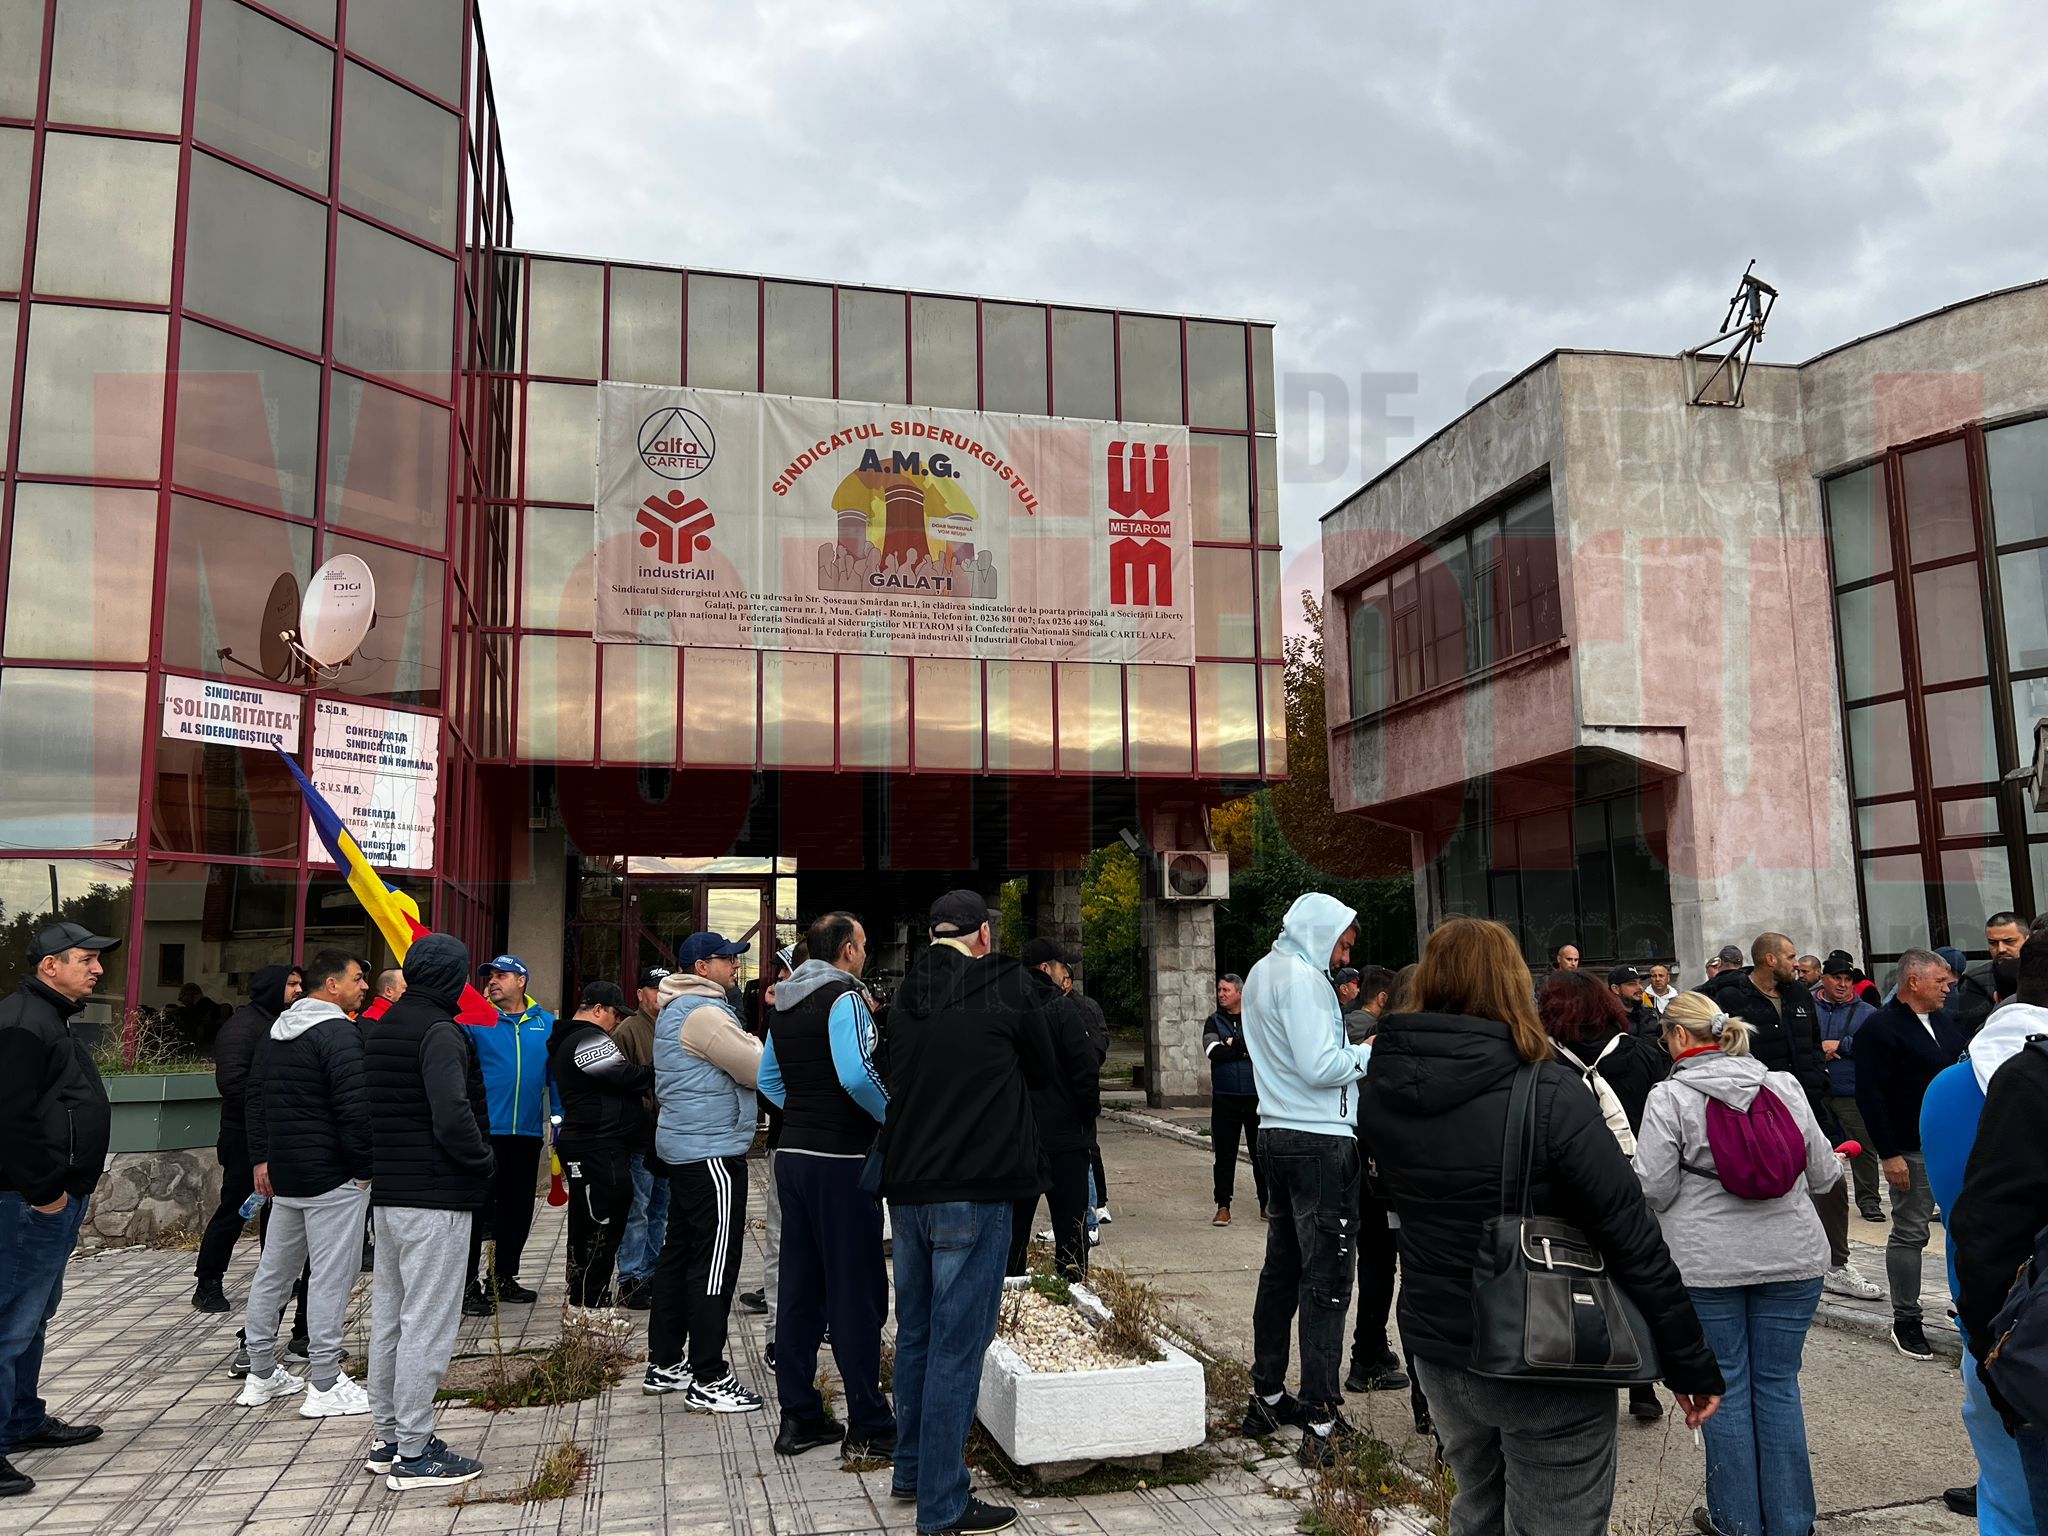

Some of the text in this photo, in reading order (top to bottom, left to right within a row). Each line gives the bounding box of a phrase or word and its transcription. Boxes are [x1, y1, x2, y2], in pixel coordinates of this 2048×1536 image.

[654, 437, 698, 455] alfa
[647, 456, 704, 470] CARTEL
[772, 421, 1042, 516] SINDICATUL SIDERURGISTUL
[858, 448, 961, 478] A.M.G.
[1110, 522, 1170, 534] METAROM
[638, 566, 714, 581] industriAll
[334, 583, 361, 591] DIGI
[868, 572, 952, 594] GALAȚI
[612, 584, 658, 595] Sindicatul
[661, 587, 720, 598] Siderurgistul
[722, 591, 748, 599] AMG
[763, 593, 792, 602] adresa
[794, 594, 803, 602] în
[805, 595, 820, 603] Str.
[823, 596, 858, 605] Șoseaua
[860, 598, 899, 606] Smârdan
[933, 602, 966, 610] clădirea
[968, 603, 1016, 613] sindicatelor
[1017, 606, 1027, 614] de
[1029, 606, 1037, 614] la
[1067, 609, 1108, 618] principală
[1117, 610, 1153, 620] Societății
[1155, 611, 1184, 621] Liberty
[622, 608, 651, 616] Afiliat
[654, 611, 664, 619] pe
[667, 610, 687, 619] plan
[690, 612, 727, 620] național
[740, 613, 782, 624] Federația
[784, 616, 825, 624] Sindicală
[902, 621, 954, 631] METAROM
[956, 624, 963, 632] și
[965, 624, 973, 632] la
[976, 624, 1029, 635] Confederația
[1031, 627, 1070, 636] Națională
[1072, 629, 1108, 637] Sindicală
[1110, 630, 1148, 639] CARTEL
[830, 607, 852, 616] Mun.
[855, 608, 881, 618] Galați
[932, 612, 962, 620] Telefon
[964, 614, 978, 622] int.
[980, 614, 1000, 622] 0236
[1001, 615, 1015, 623] 801
[1018, 616, 1035, 624] 007;
[1073, 618, 1087, 626] 449
[1089, 619, 1105, 627] 864.
[738, 624, 751, 632] iar
[826, 629, 867, 638] Federația
[870, 630, 916, 640] Europeană
[918, 632, 963, 642] industriAll
[966, 635, 972, 643] și
[1020, 637, 1047, 645] Global
[1050, 638, 1076, 646] Union.
[205, 686, 263, 704] SINDICATUL
[317, 704, 349, 716] C.S.D.R.
[180, 722, 192, 734] AL
[346, 739, 406, 755] SINDICATELOR
[315, 748, 377, 764] DEMOCRATICE
[379, 756, 393, 766] DIN
